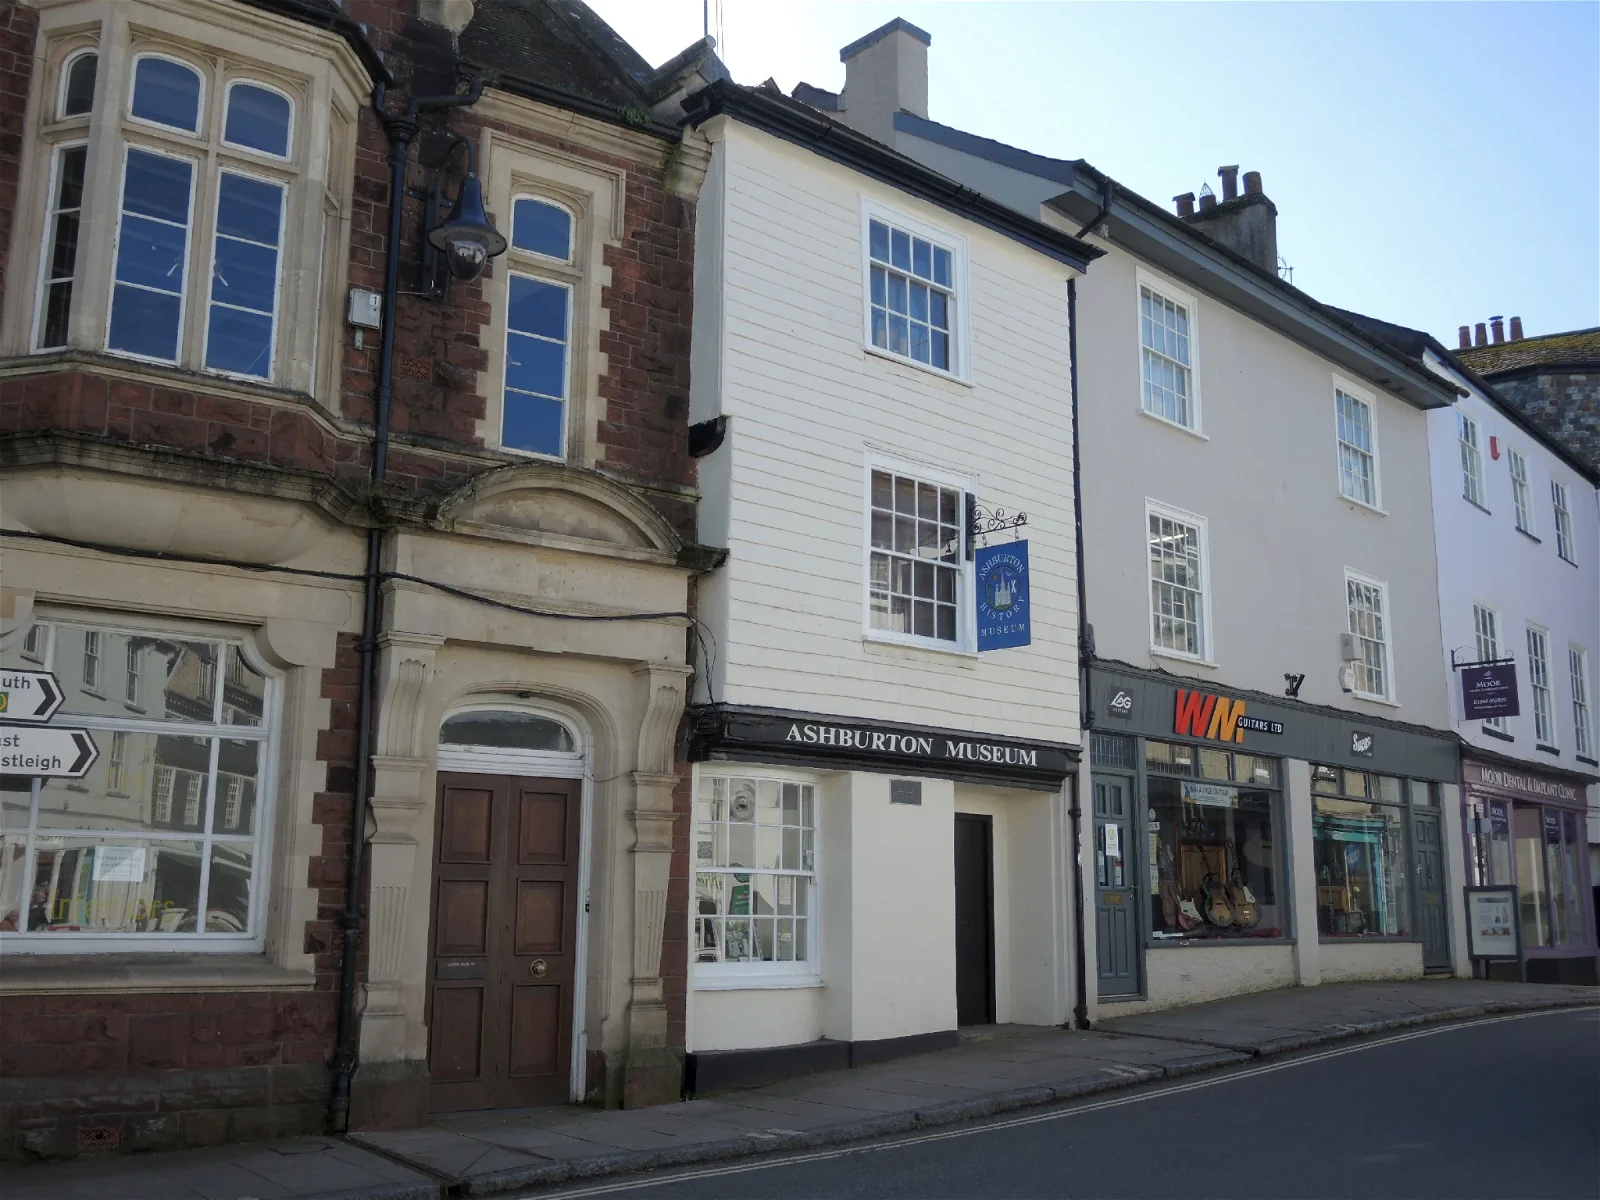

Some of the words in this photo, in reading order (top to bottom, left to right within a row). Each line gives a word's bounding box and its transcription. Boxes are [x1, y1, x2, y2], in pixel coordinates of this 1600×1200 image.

[979, 553, 1025, 580] ASHBURTON
[980, 596, 1025, 621] HISTORY
[981, 623, 1025, 637] MUSEUM
[1476, 680, 1501, 688] MOOR
[1238, 716, 1268, 731] GUITARS
[1271, 723, 1282, 733] LTD
[0, 734, 19, 747] st
[786, 723, 934, 755] ASHBURTON
[945, 740, 1038, 767] MUSEUM
[1482, 767, 1503, 786] MOOR
[1503, 772, 1527, 791] DENTAL
[1533, 779, 1558, 797] IMPLANT
[1558, 784, 1576, 800] CLINIC
